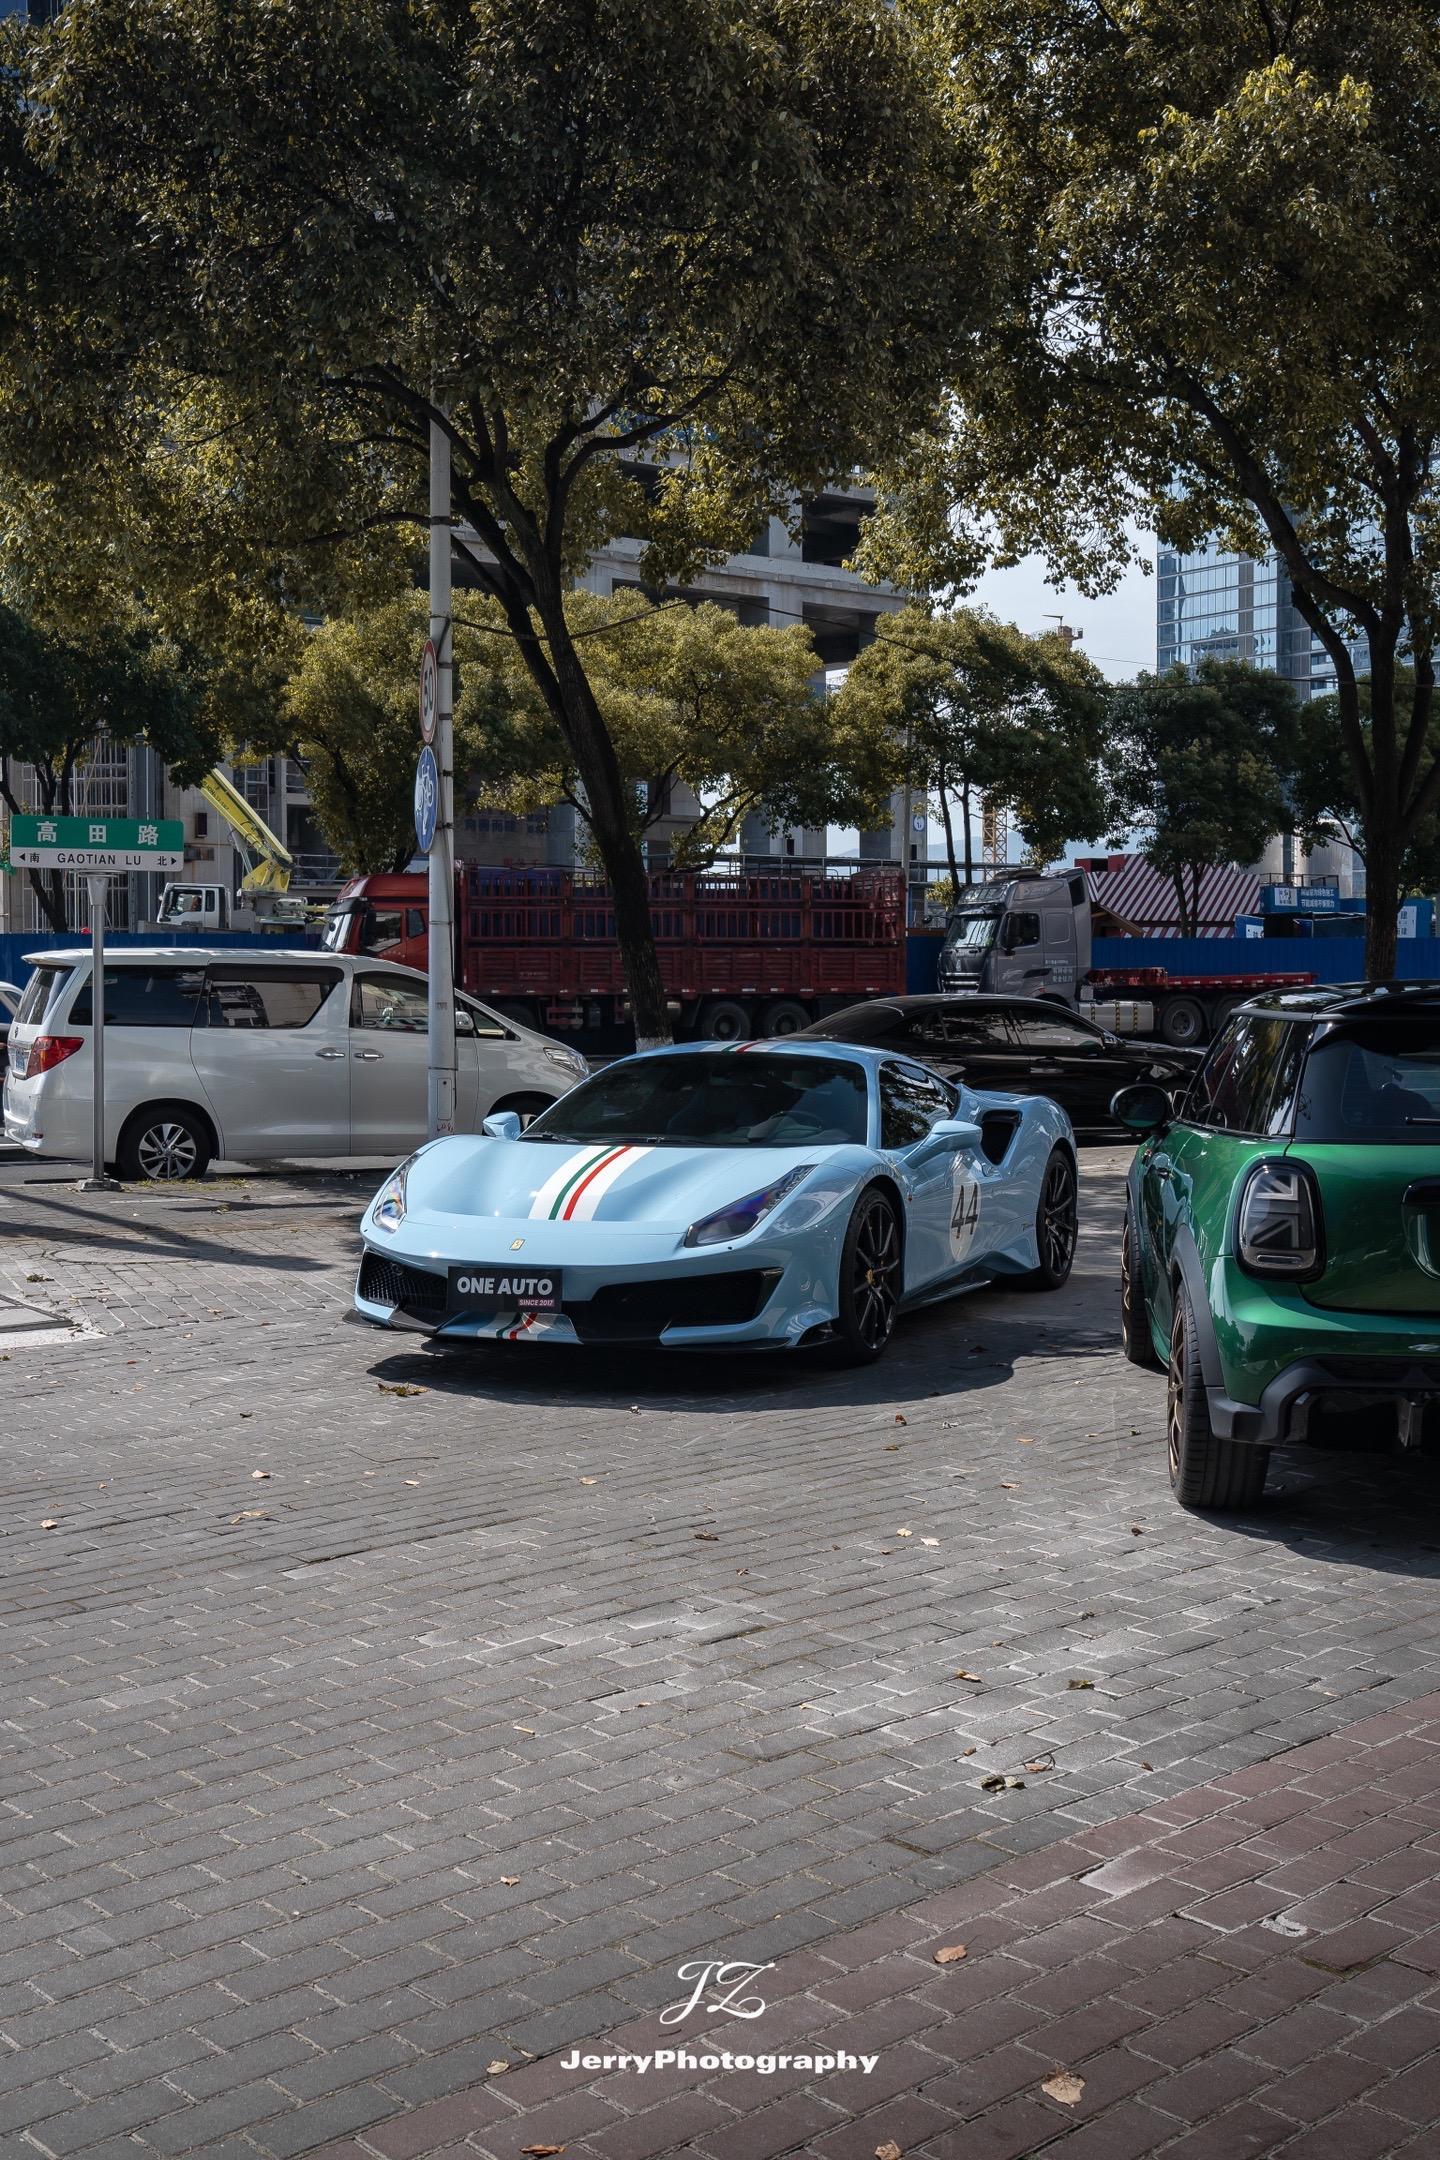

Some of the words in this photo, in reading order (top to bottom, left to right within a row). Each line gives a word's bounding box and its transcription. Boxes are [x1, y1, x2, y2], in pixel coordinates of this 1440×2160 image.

[36, 821, 159, 846] 高田路
[29, 852, 40, 863] 南
[57, 853, 116, 865] GAOTIAN
[125, 855, 141, 865] LU
[157, 857, 167, 866] 北
[951, 1182, 978, 1239] 44
[457, 1276, 494, 1295] ONE
[497, 1278, 553, 1295] AUTO
